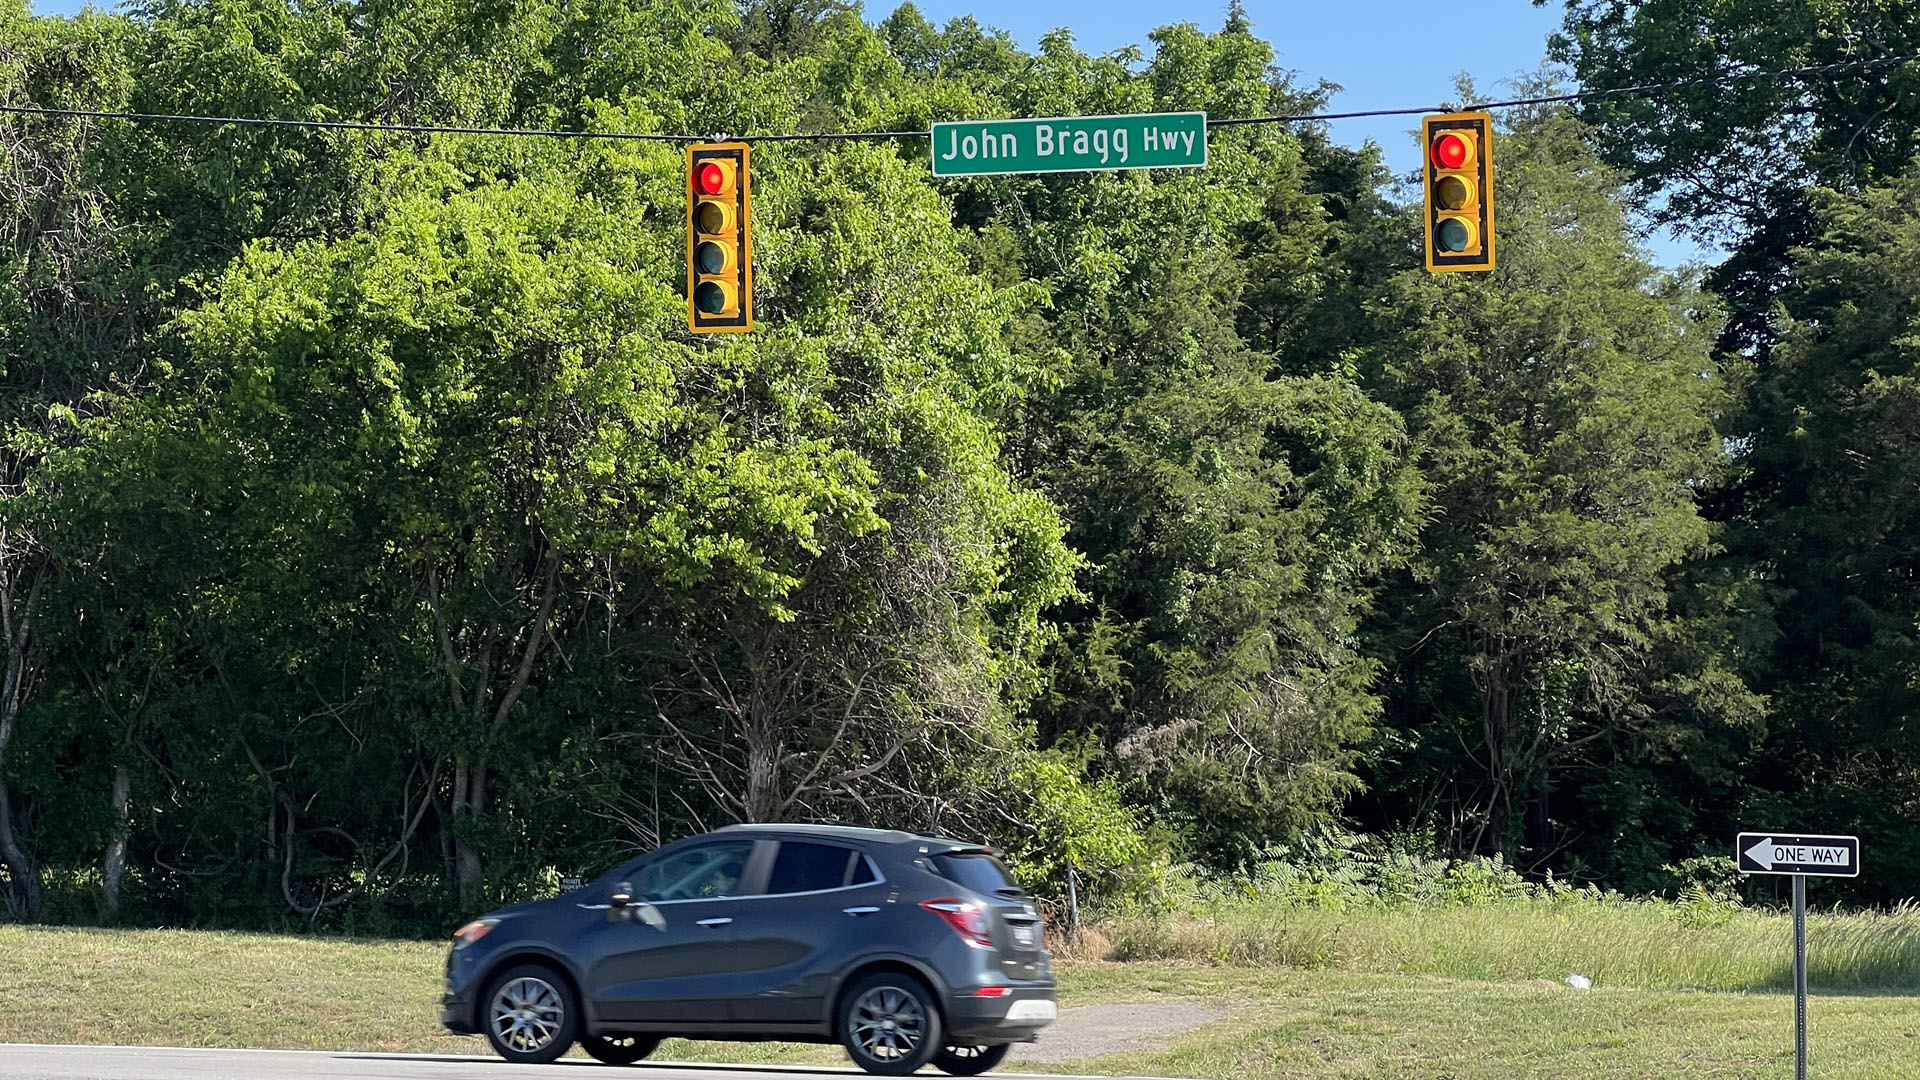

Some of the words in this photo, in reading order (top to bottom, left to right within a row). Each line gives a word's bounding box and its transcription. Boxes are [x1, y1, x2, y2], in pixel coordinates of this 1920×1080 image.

[942, 128, 1017, 160] John
[1036, 125, 1128, 164] Bragg
[1143, 127, 1196, 156] Hwy
[1774, 847, 1806, 862] ONE
[1811, 848, 1844, 863] WAY
